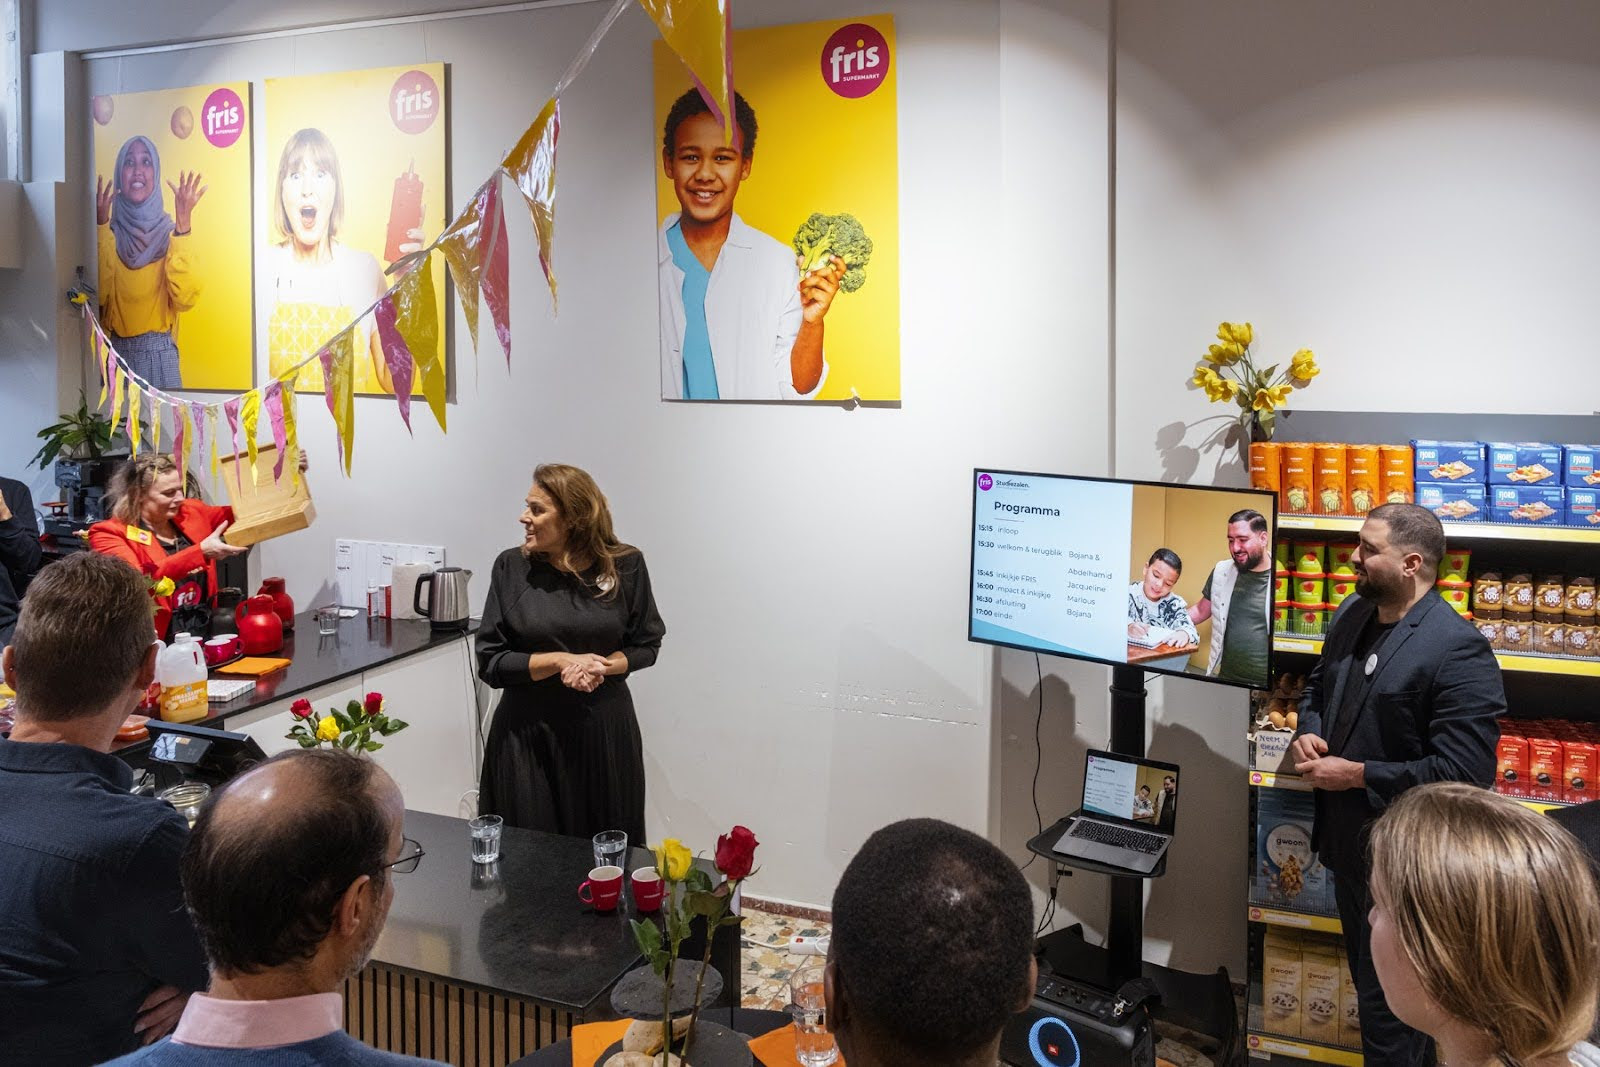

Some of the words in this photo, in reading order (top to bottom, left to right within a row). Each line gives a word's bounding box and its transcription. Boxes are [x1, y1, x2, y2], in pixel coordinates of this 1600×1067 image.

[830, 39, 880, 83] fris
[843, 73, 880, 82] SUPERMARKT
[395, 84, 432, 121] fris
[207, 100, 239, 136] fris
[994, 501, 1061, 517] Programma
[978, 524, 993, 532] 15:15
[997, 527, 1019, 535] inloop
[978, 540, 995, 548] 15:30
[997, 543, 1023, 552] welkom
[1031, 547, 1063, 557] terugblik
[1068, 551, 1094, 561] Bojana
[977, 569, 994, 577] 15:45
[1021, 575, 1037, 583] FRIS
[1067, 568, 1113, 580] Abdelhamid
[976, 582, 994, 590] 16:00
[996, 585, 1020, 595] impact
[1067, 581, 1107, 593] Jacqueline
[976, 595, 993, 604] 16:30
[995, 598, 1026, 610] afsluiting
[975, 608, 993, 617] 17:00
[994, 612, 1013, 620] einde
[1066, 609, 1092, 619] Bojana
[1276, 838, 1303, 846] gwoon
